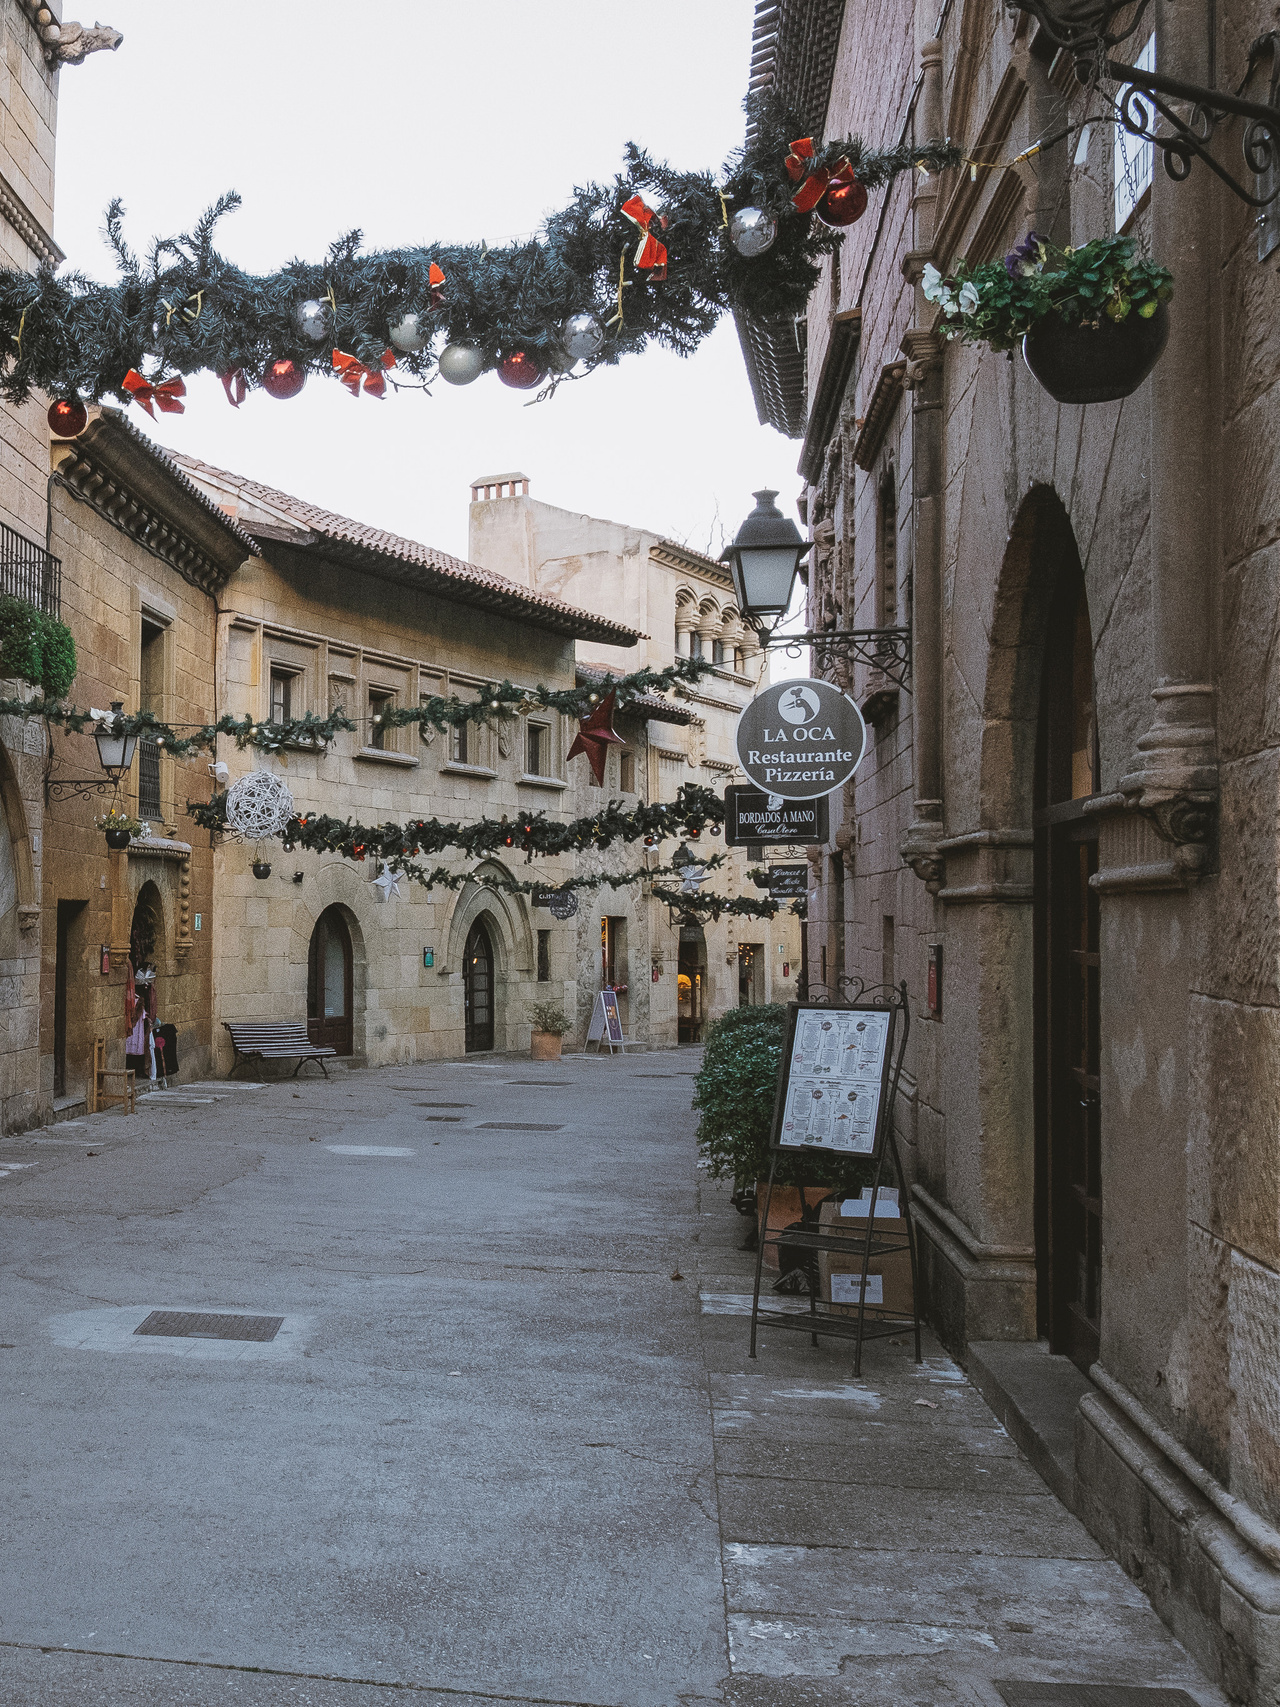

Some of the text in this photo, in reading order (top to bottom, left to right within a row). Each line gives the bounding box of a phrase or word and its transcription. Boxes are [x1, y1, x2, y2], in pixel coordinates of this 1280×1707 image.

[763, 727, 836, 743] LA OCA
[748, 749, 853, 765] Restaurante
[765, 767, 836, 783] Pizzería
[739, 810, 815, 824] BORDADOS A MANO
[754, 823, 777, 834] Casa
